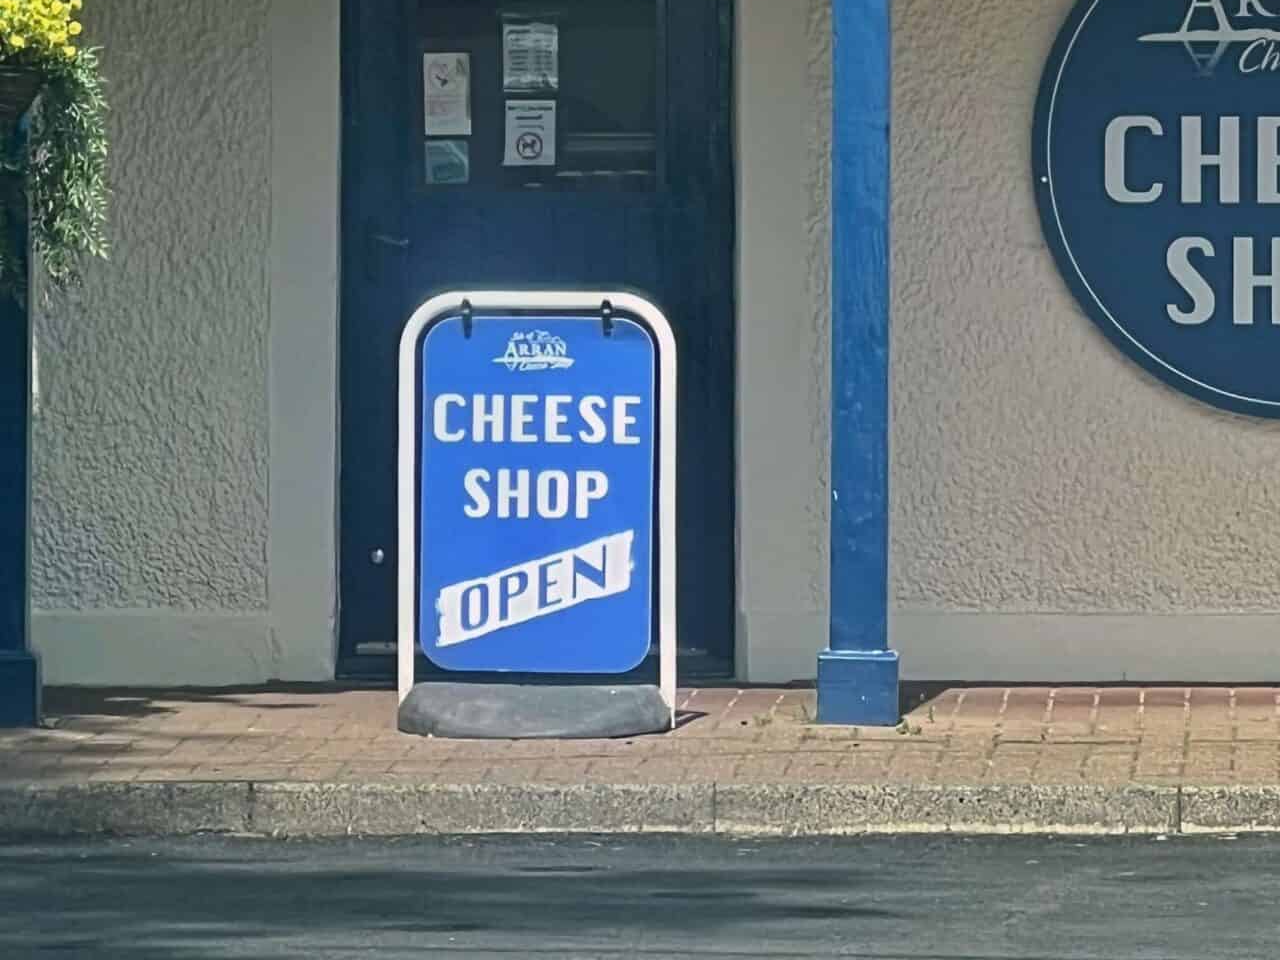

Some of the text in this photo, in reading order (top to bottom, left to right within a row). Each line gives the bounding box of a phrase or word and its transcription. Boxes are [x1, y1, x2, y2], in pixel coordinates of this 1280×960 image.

[504, 341, 567, 362] ARRAN
[433, 393, 641, 445] CHEESE
[463, 469, 609, 519] SHOP
[460, 544, 609, 632] OPEN
